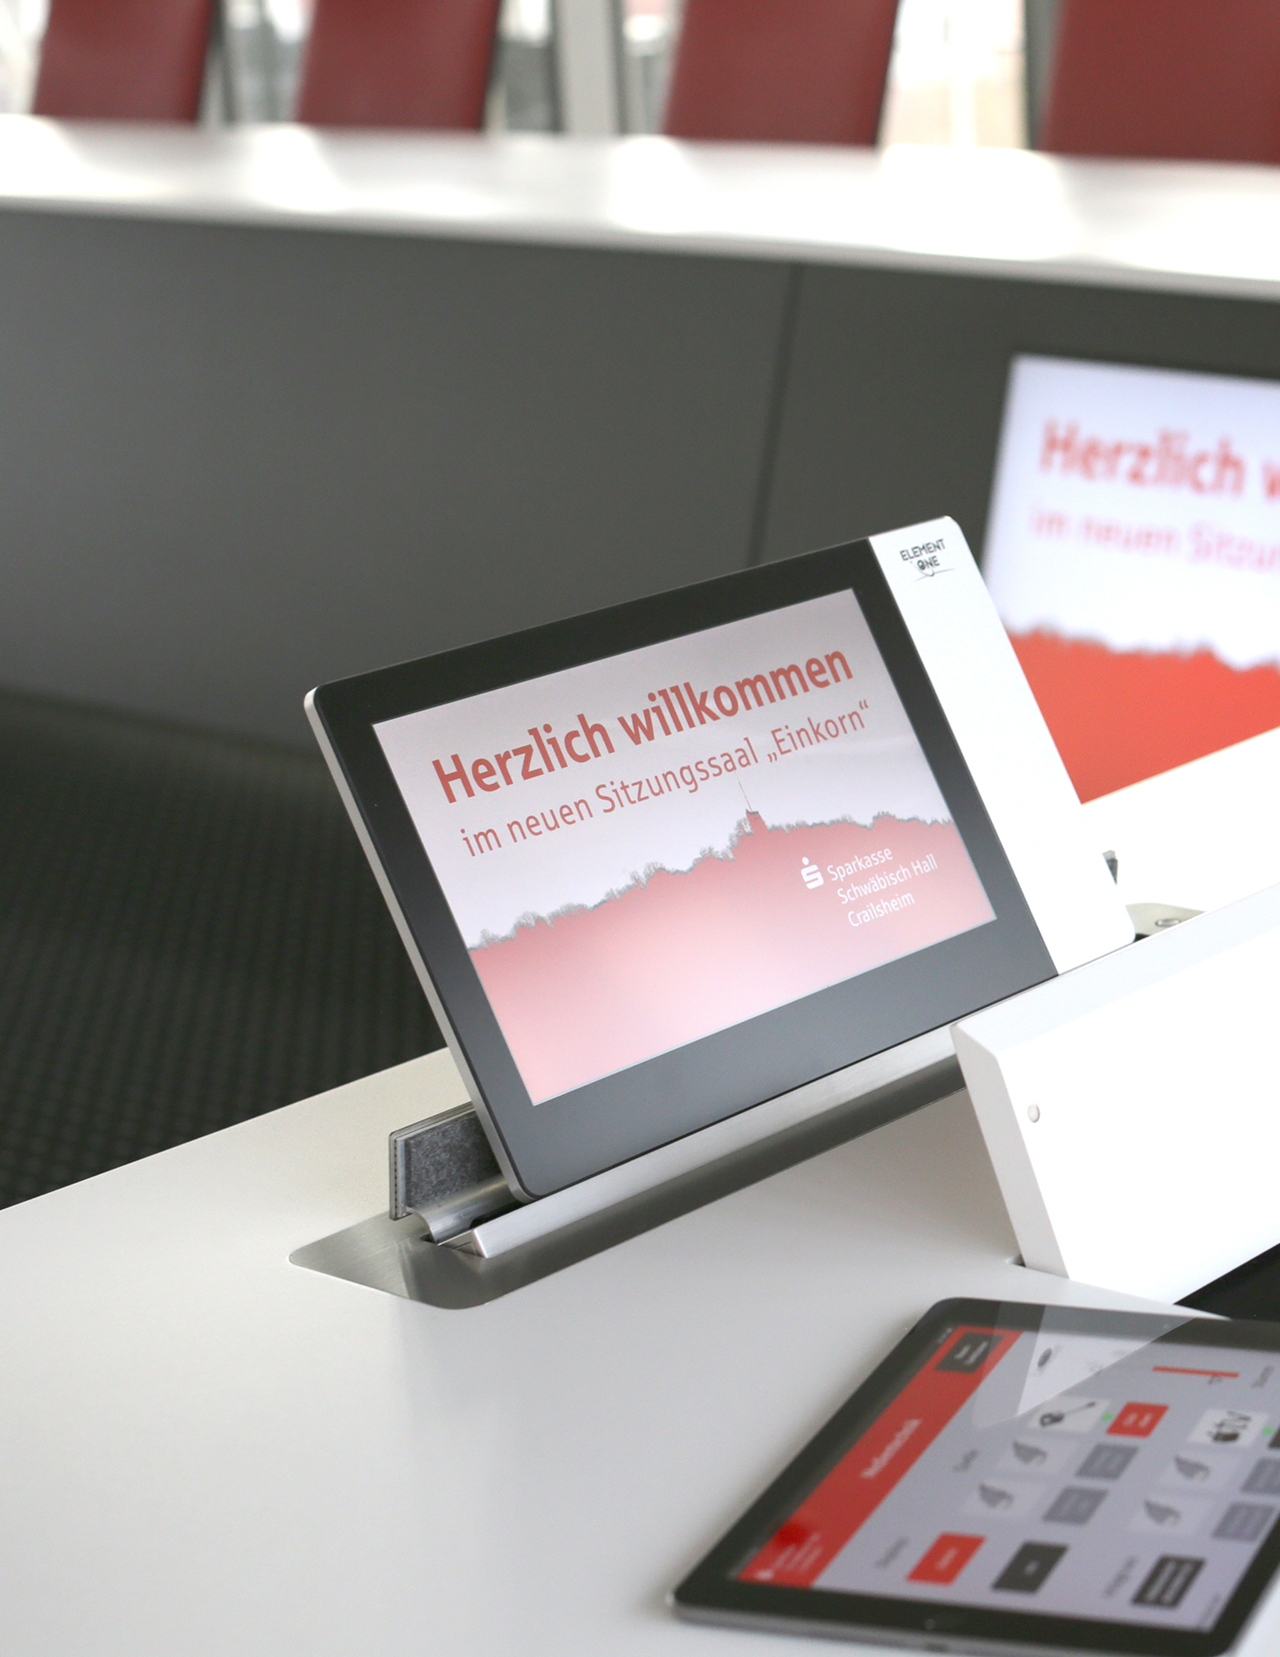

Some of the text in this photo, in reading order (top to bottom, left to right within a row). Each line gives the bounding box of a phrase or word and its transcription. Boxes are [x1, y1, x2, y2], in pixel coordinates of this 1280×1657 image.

[1039, 419, 1246, 496] Herzlich
[899, 538, 946, 561] ELEMENT
[917, 555, 940, 571] ONE
[432, 650, 854, 804] Herzlich willkommen
[460, 828, 502, 857] im
[506, 798, 594, 843] neuen
[595, 737, 760, 814] Sitzungssaal
[827, 848, 894, 882] Sparkasse
[837, 853, 938, 905] Schwäbisch Hall
[847, 892, 916, 927] Crailsheim
